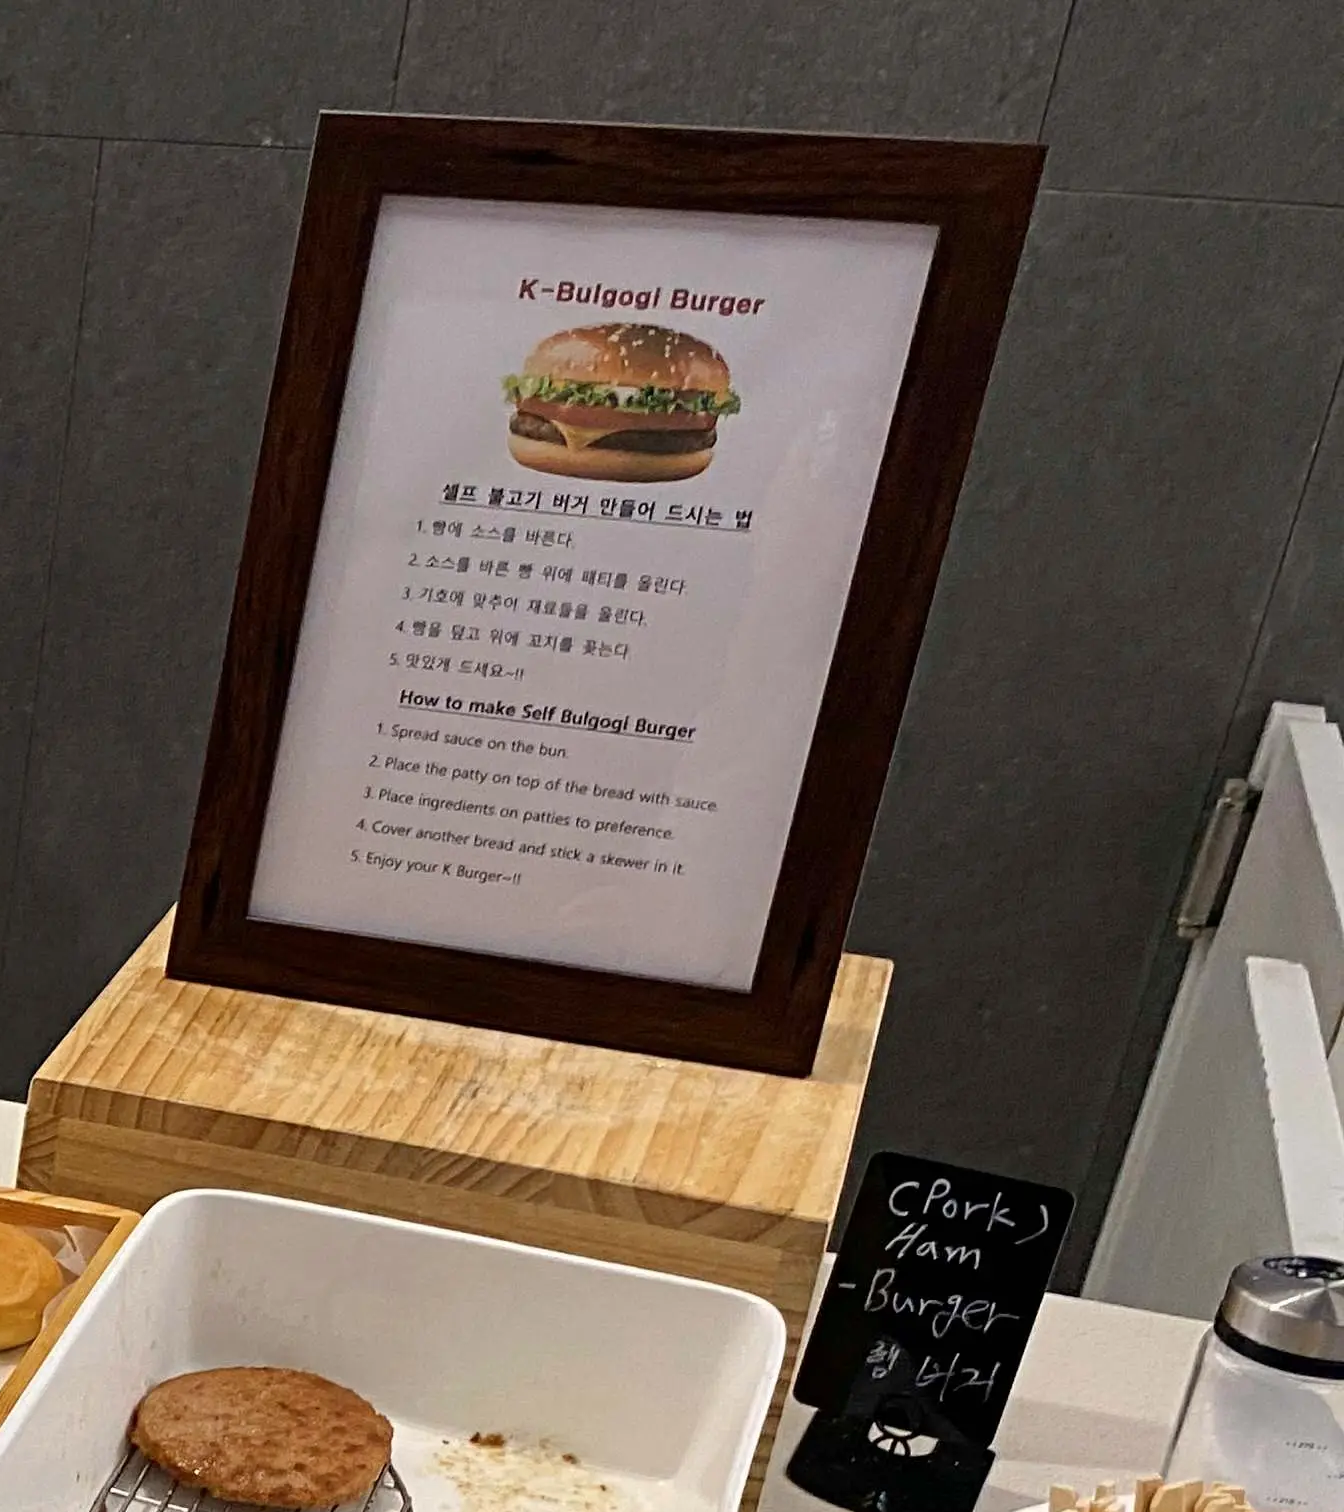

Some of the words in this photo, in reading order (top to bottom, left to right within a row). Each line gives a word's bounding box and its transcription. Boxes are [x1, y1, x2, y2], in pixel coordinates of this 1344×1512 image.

[518, 278, 662, 310] K-Bulgogi
[669, 287, 765, 316] Burger
[443, 483, 478, 502] 셀프
[488, 487, 542, 510] 불고기
[552, 493, 589, 514] 버거
[600, 497, 656, 521] 만들어
[665, 504, 723, 527] 드시는
[735, 509, 753, 529] 법
[432, 520, 463, 538] 빵에
[470, 524, 516, 543] 소스를
[425, 555, 470, 573] 소스를
[479, 559, 510, 577] 바른
[542, 565, 573, 583] 위에
[581, 569, 628, 590] 패티를
[419, 587, 465, 607] 기호에
[489, 628, 520, 646] 위에
[406, 653, 452, 673] 맛있게
[399, 688, 441, 707] How
[445, 695, 463, 711] to
[468, 700, 517, 718] make
[520, 703, 557, 722] Self
[560, 708, 630, 734] Bulgogi
[634, 717, 697, 741] Burger
[391, 724, 440, 744] Spread
[443, 732, 484, 749] sauce
[487, 738, 507, 751] on
[511, 739, 535, 755] the
[384, 756, 421, 774] Place
[424, 760, 448, 777] the
[451, 766, 489, 785] patty
[492, 773, 512, 785] on
[515, 775, 541, 791] top
[544, 778, 563, 791] of
[564, 781, 589, 796] the
[592, 783, 636, 802] bread
[639, 792, 672, 807] with
[378, 787, 415, 806] Place
[418, 792, 496, 817] ingredients
[499, 806, 520, 819] on
[522, 808, 571, 826] patties
[574, 816, 592, 830] to
[365, 850, 403, 871] Enjoy
[406, 859, 439, 873] your
[442, 864, 453, 877] K
[371, 820, 412, 837] Cover
[415, 827, 470, 846] another
[473, 833, 515, 852] bread
[518, 841, 547, 857] and
[550, 846, 582, 863] stick
[585, 852, 596, 864] a
[600, 854, 650, 872] skewer
[653, 858, 669, 874] in
[884, 1222, 982, 1271] Ham
